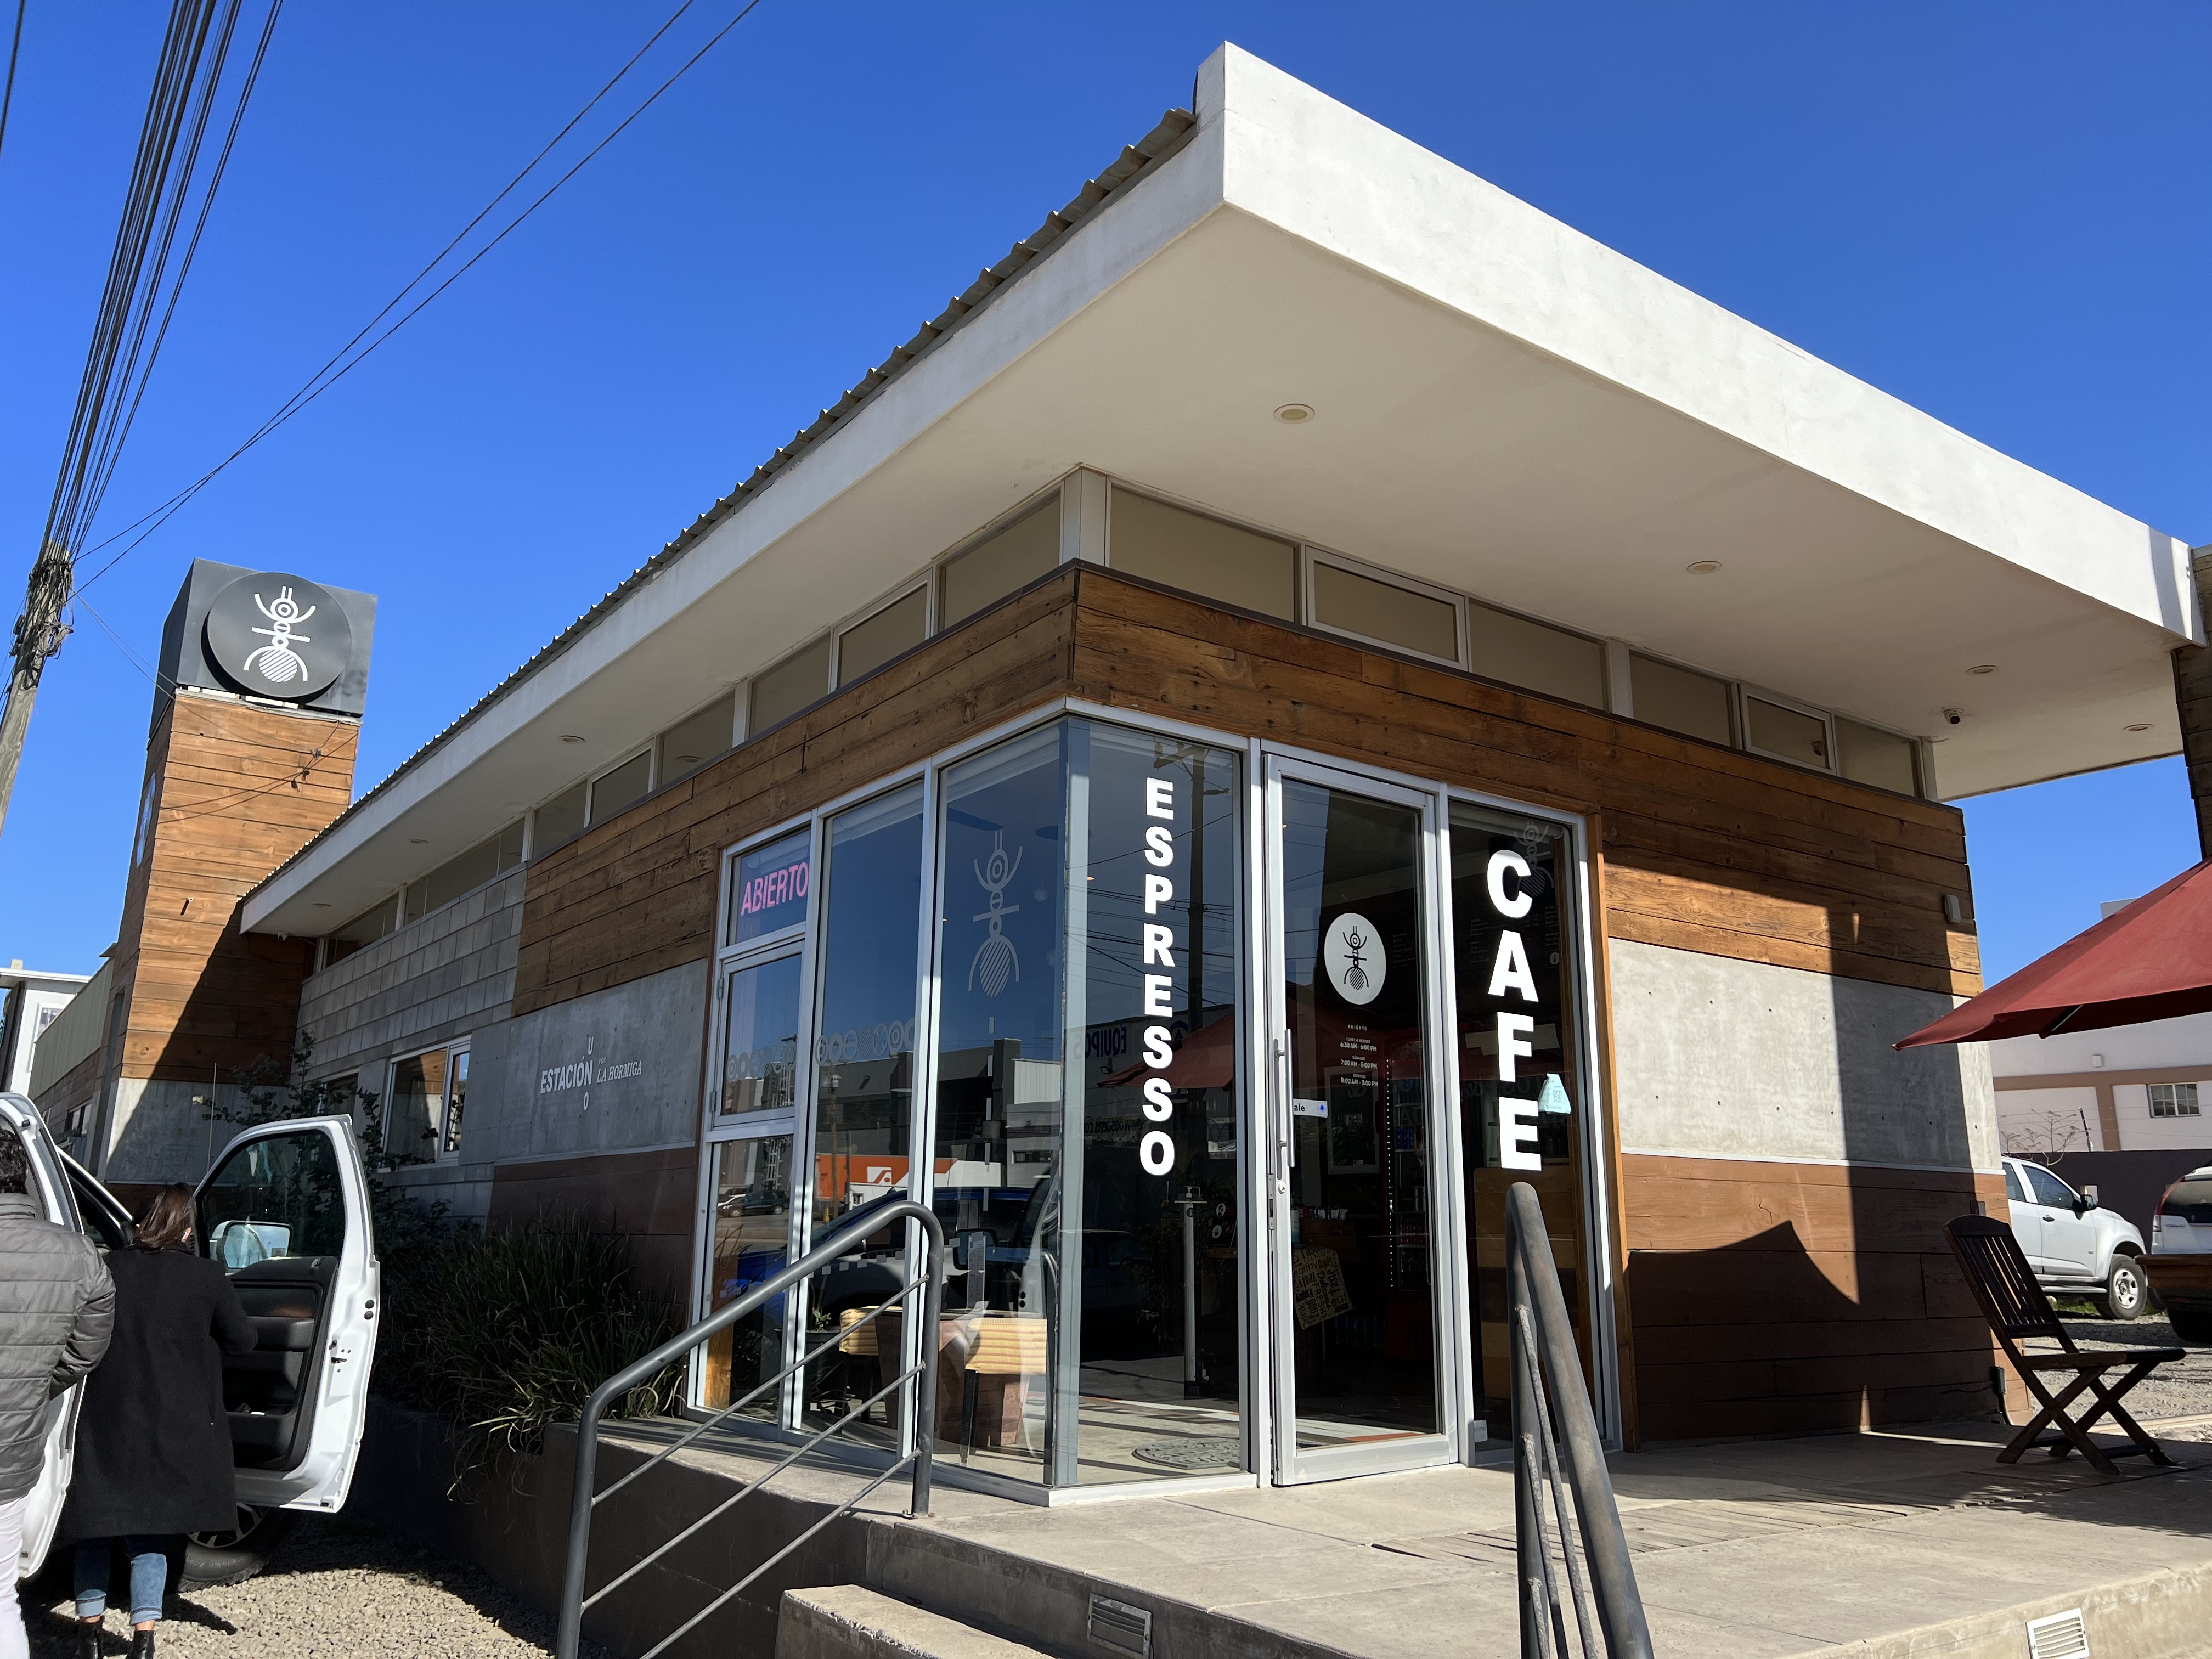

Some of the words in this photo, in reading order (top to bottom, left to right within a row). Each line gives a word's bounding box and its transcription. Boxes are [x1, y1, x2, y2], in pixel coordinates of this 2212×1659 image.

[741, 862, 809, 916] ABIERTO
[1139, 777, 1175, 1176] ESPRESSO
[1487, 849, 1542, 1171] CAFE
[540, 1055, 594, 1094] ESTACIÓN
[596, 1068, 607, 1084] LA
[608, 1060, 643, 1081] HORMIGA
[599, 1056, 607, 1065] POR
[1294, 1103, 1305, 1111] ale
[1294, 1261, 1318, 1277] ealthy
[1312, 1283, 1327, 1314] FRESH
